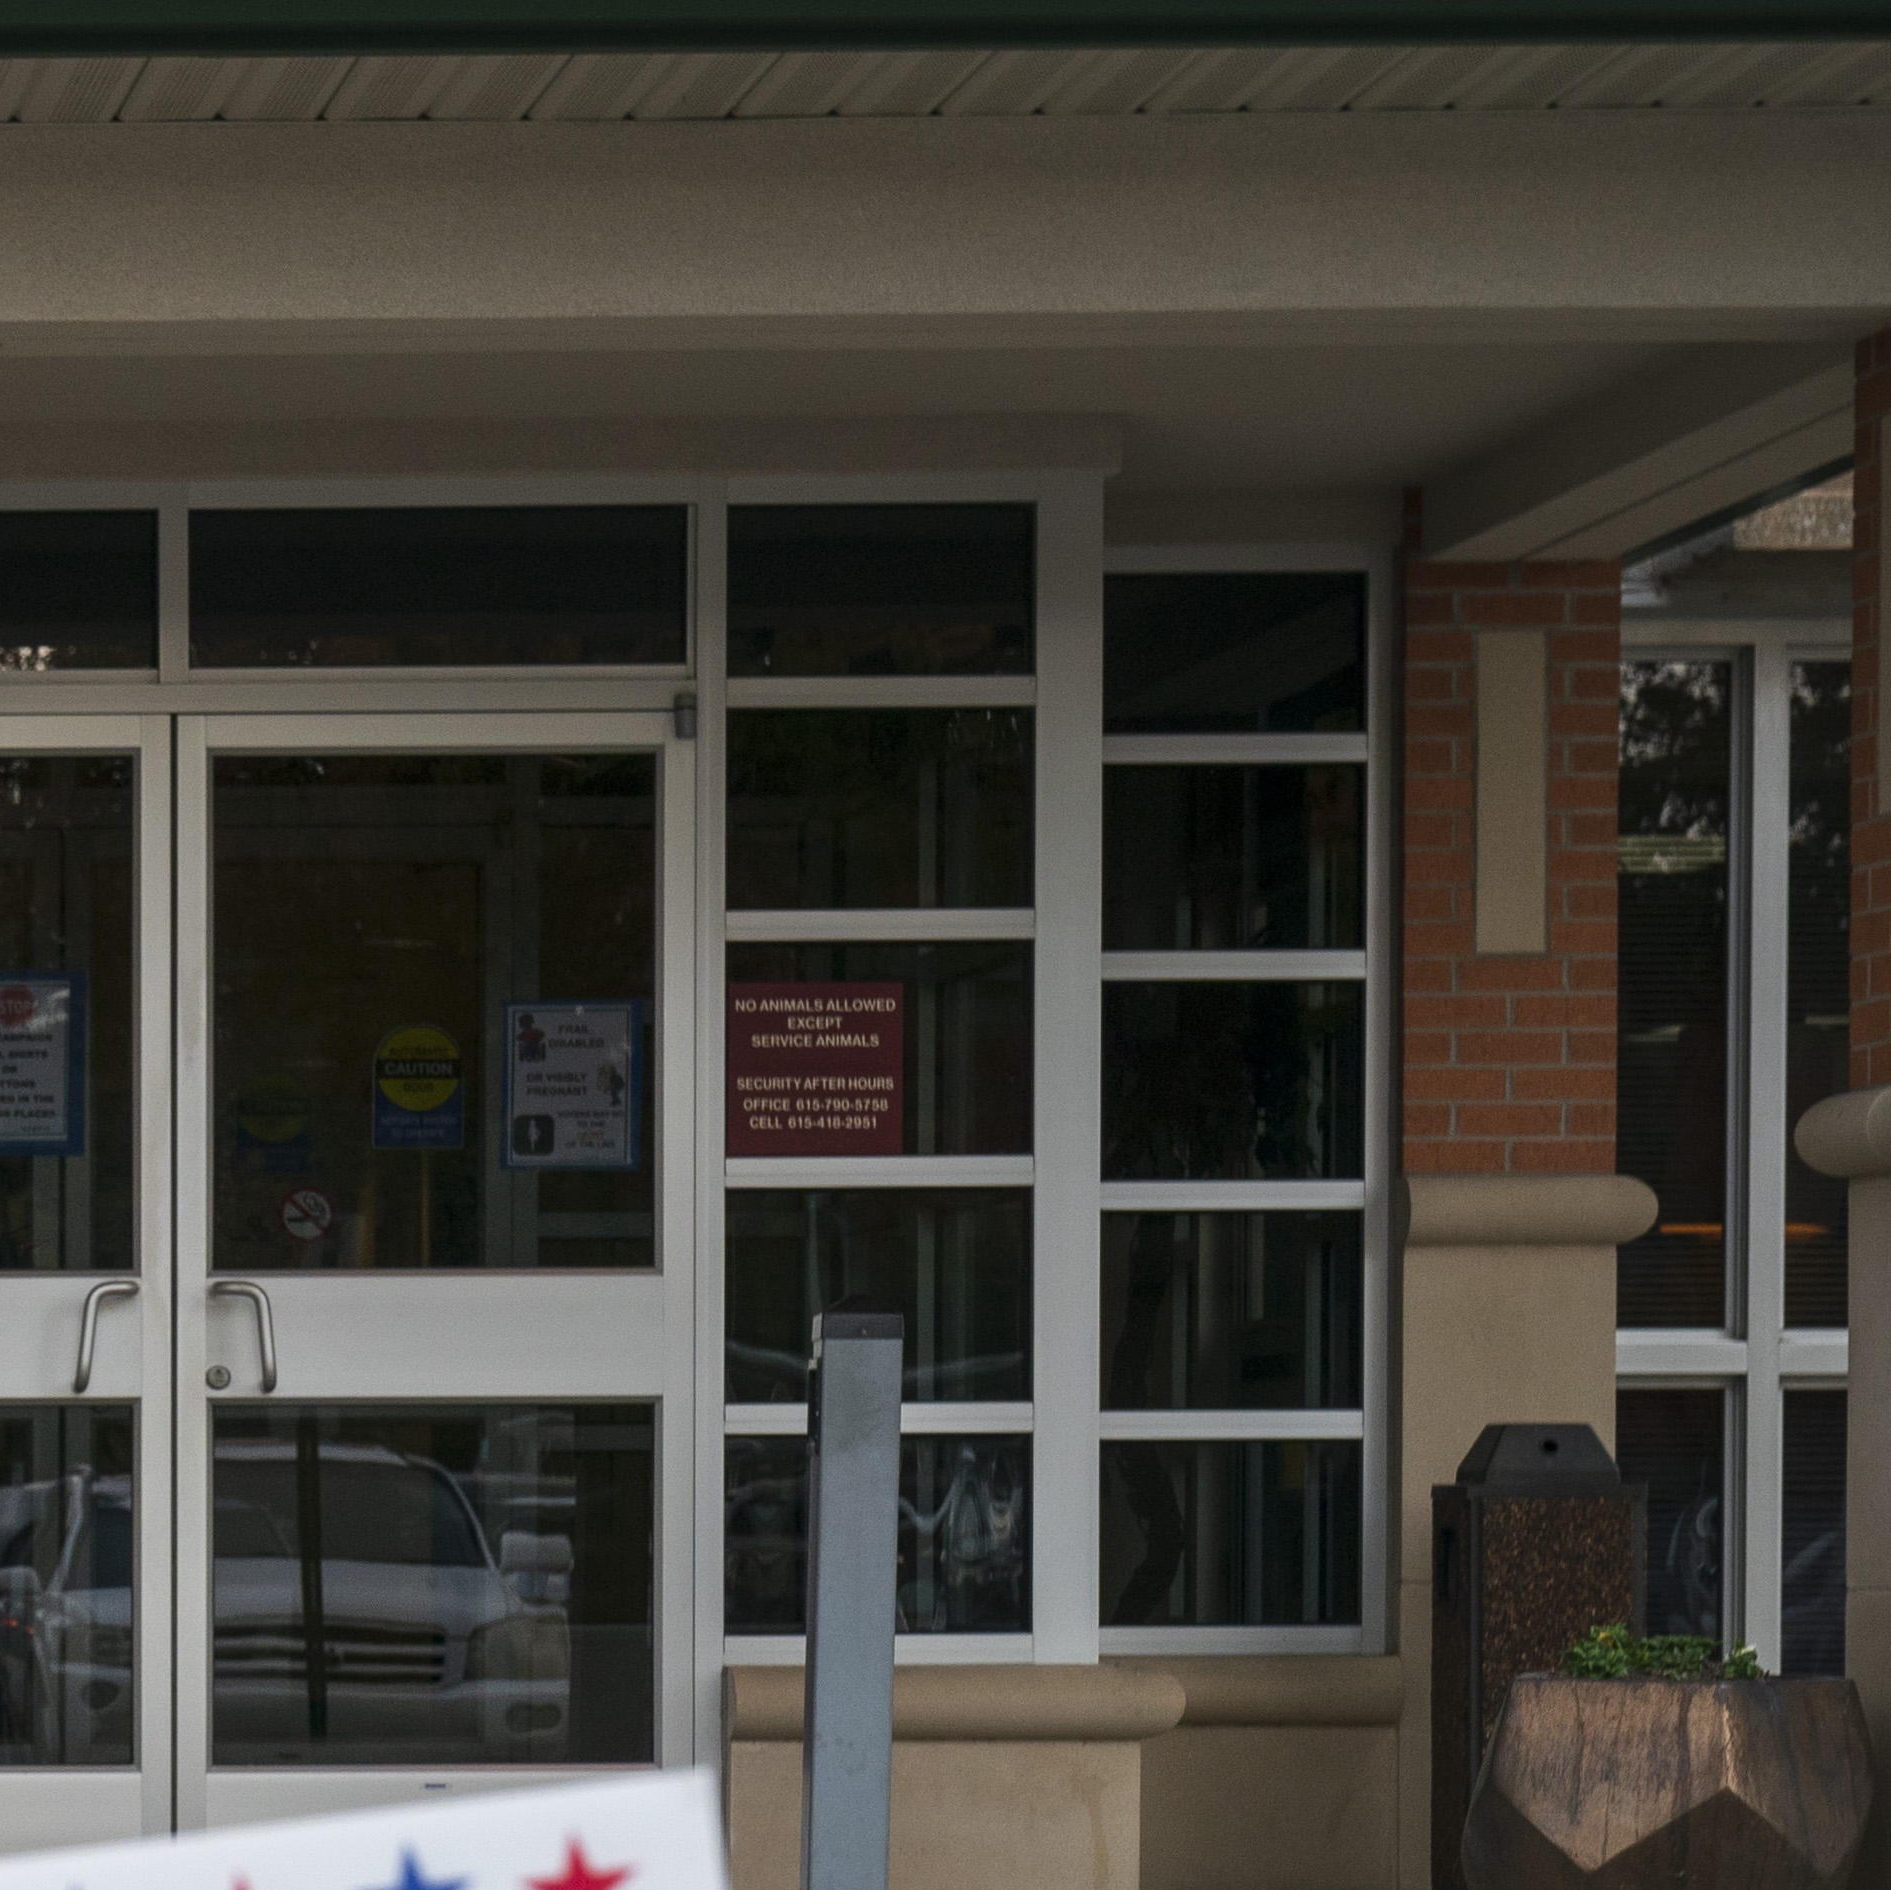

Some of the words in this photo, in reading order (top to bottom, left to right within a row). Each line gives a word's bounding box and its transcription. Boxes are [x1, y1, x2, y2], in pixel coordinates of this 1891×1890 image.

[735, 998, 757, 1012] NO
[759, 998, 824, 1012] ANIMALS
[826, 998, 897, 1012] ALLOWED
[787, 1017, 843, 1031] EXCEPT
[751, 1034, 812, 1048] SERVICE
[815, 1034, 880, 1048] ANIMALS
[384, 1062, 454, 1076] CAUTION
[736, 1077, 802, 1091] SECURITY
[803, 1077, 846, 1091] AFTER
[848, 1077, 895, 1091] HOURS
[743, 1098, 791, 1112] OFFICE
[749, 1116, 783, 1130] CELL
